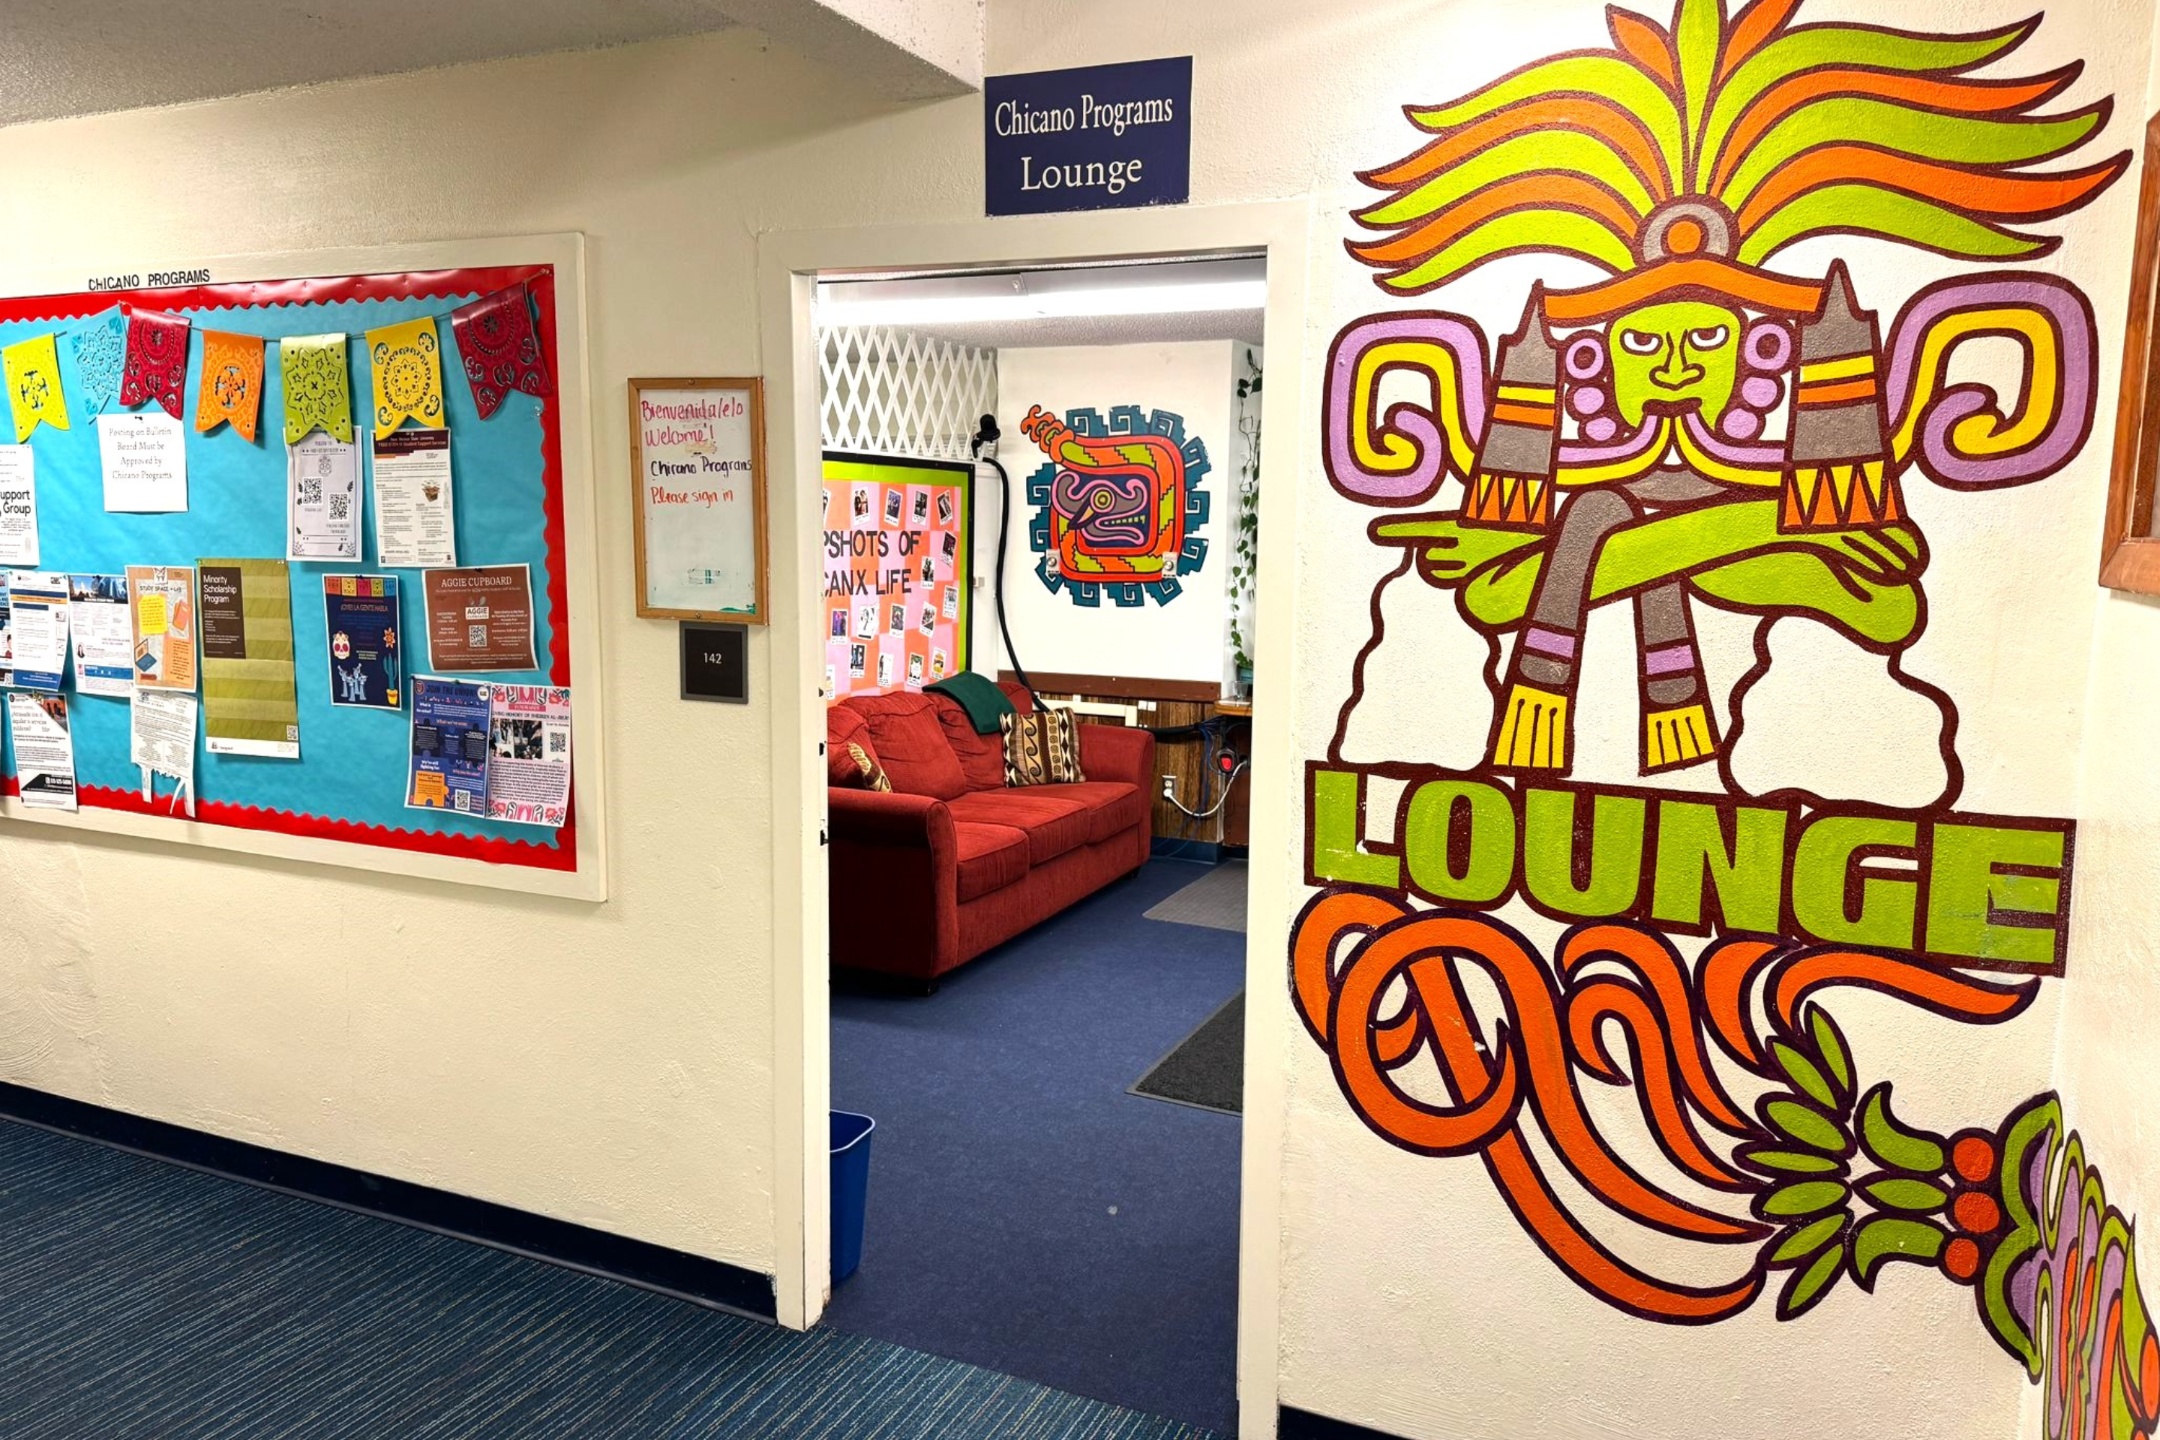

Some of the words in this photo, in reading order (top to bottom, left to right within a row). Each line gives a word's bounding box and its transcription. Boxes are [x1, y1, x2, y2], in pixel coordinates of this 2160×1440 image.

[995, 100, 1075, 136] Chicano
[1081, 94, 1173, 136] Programs
[1021, 156, 1143, 194] Lounge
[88, 274, 140, 290] CHICANO
[148, 269, 210, 286] PROGRAMS
[109, 427, 134, 438] Posting
[146, 426, 171, 436] Bulletin
[117, 441, 137, 450] Board
[139, 441, 155, 450] Must
[157, 441, 164, 450] be
[121, 456, 152, 467] Approved
[155, 456, 162, 467] by
[112, 470, 139, 479] Chicano
[141, 470, 172, 482] Programs
[0, 490, 30, 503] upport
[651, 486, 688, 504] Please
[692, 490, 717, 508] sign
[723, 489, 733, 501] in
[3, 502, 31, 516] Group
[898, 530, 922, 557] OF
[203, 574, 228, 585] Minority
[441, 578, 467, 588] AGGIE
[467, 576, 512, 587] CUPBOARD
[876, 569, 911, 595] LIFE
[203, 584, 237, 595] Scholarship
[204, 594, 230, 604] Program
[703, 652, 722, 664] 142
[1303, 760, 2077, 978] LOUNGE
